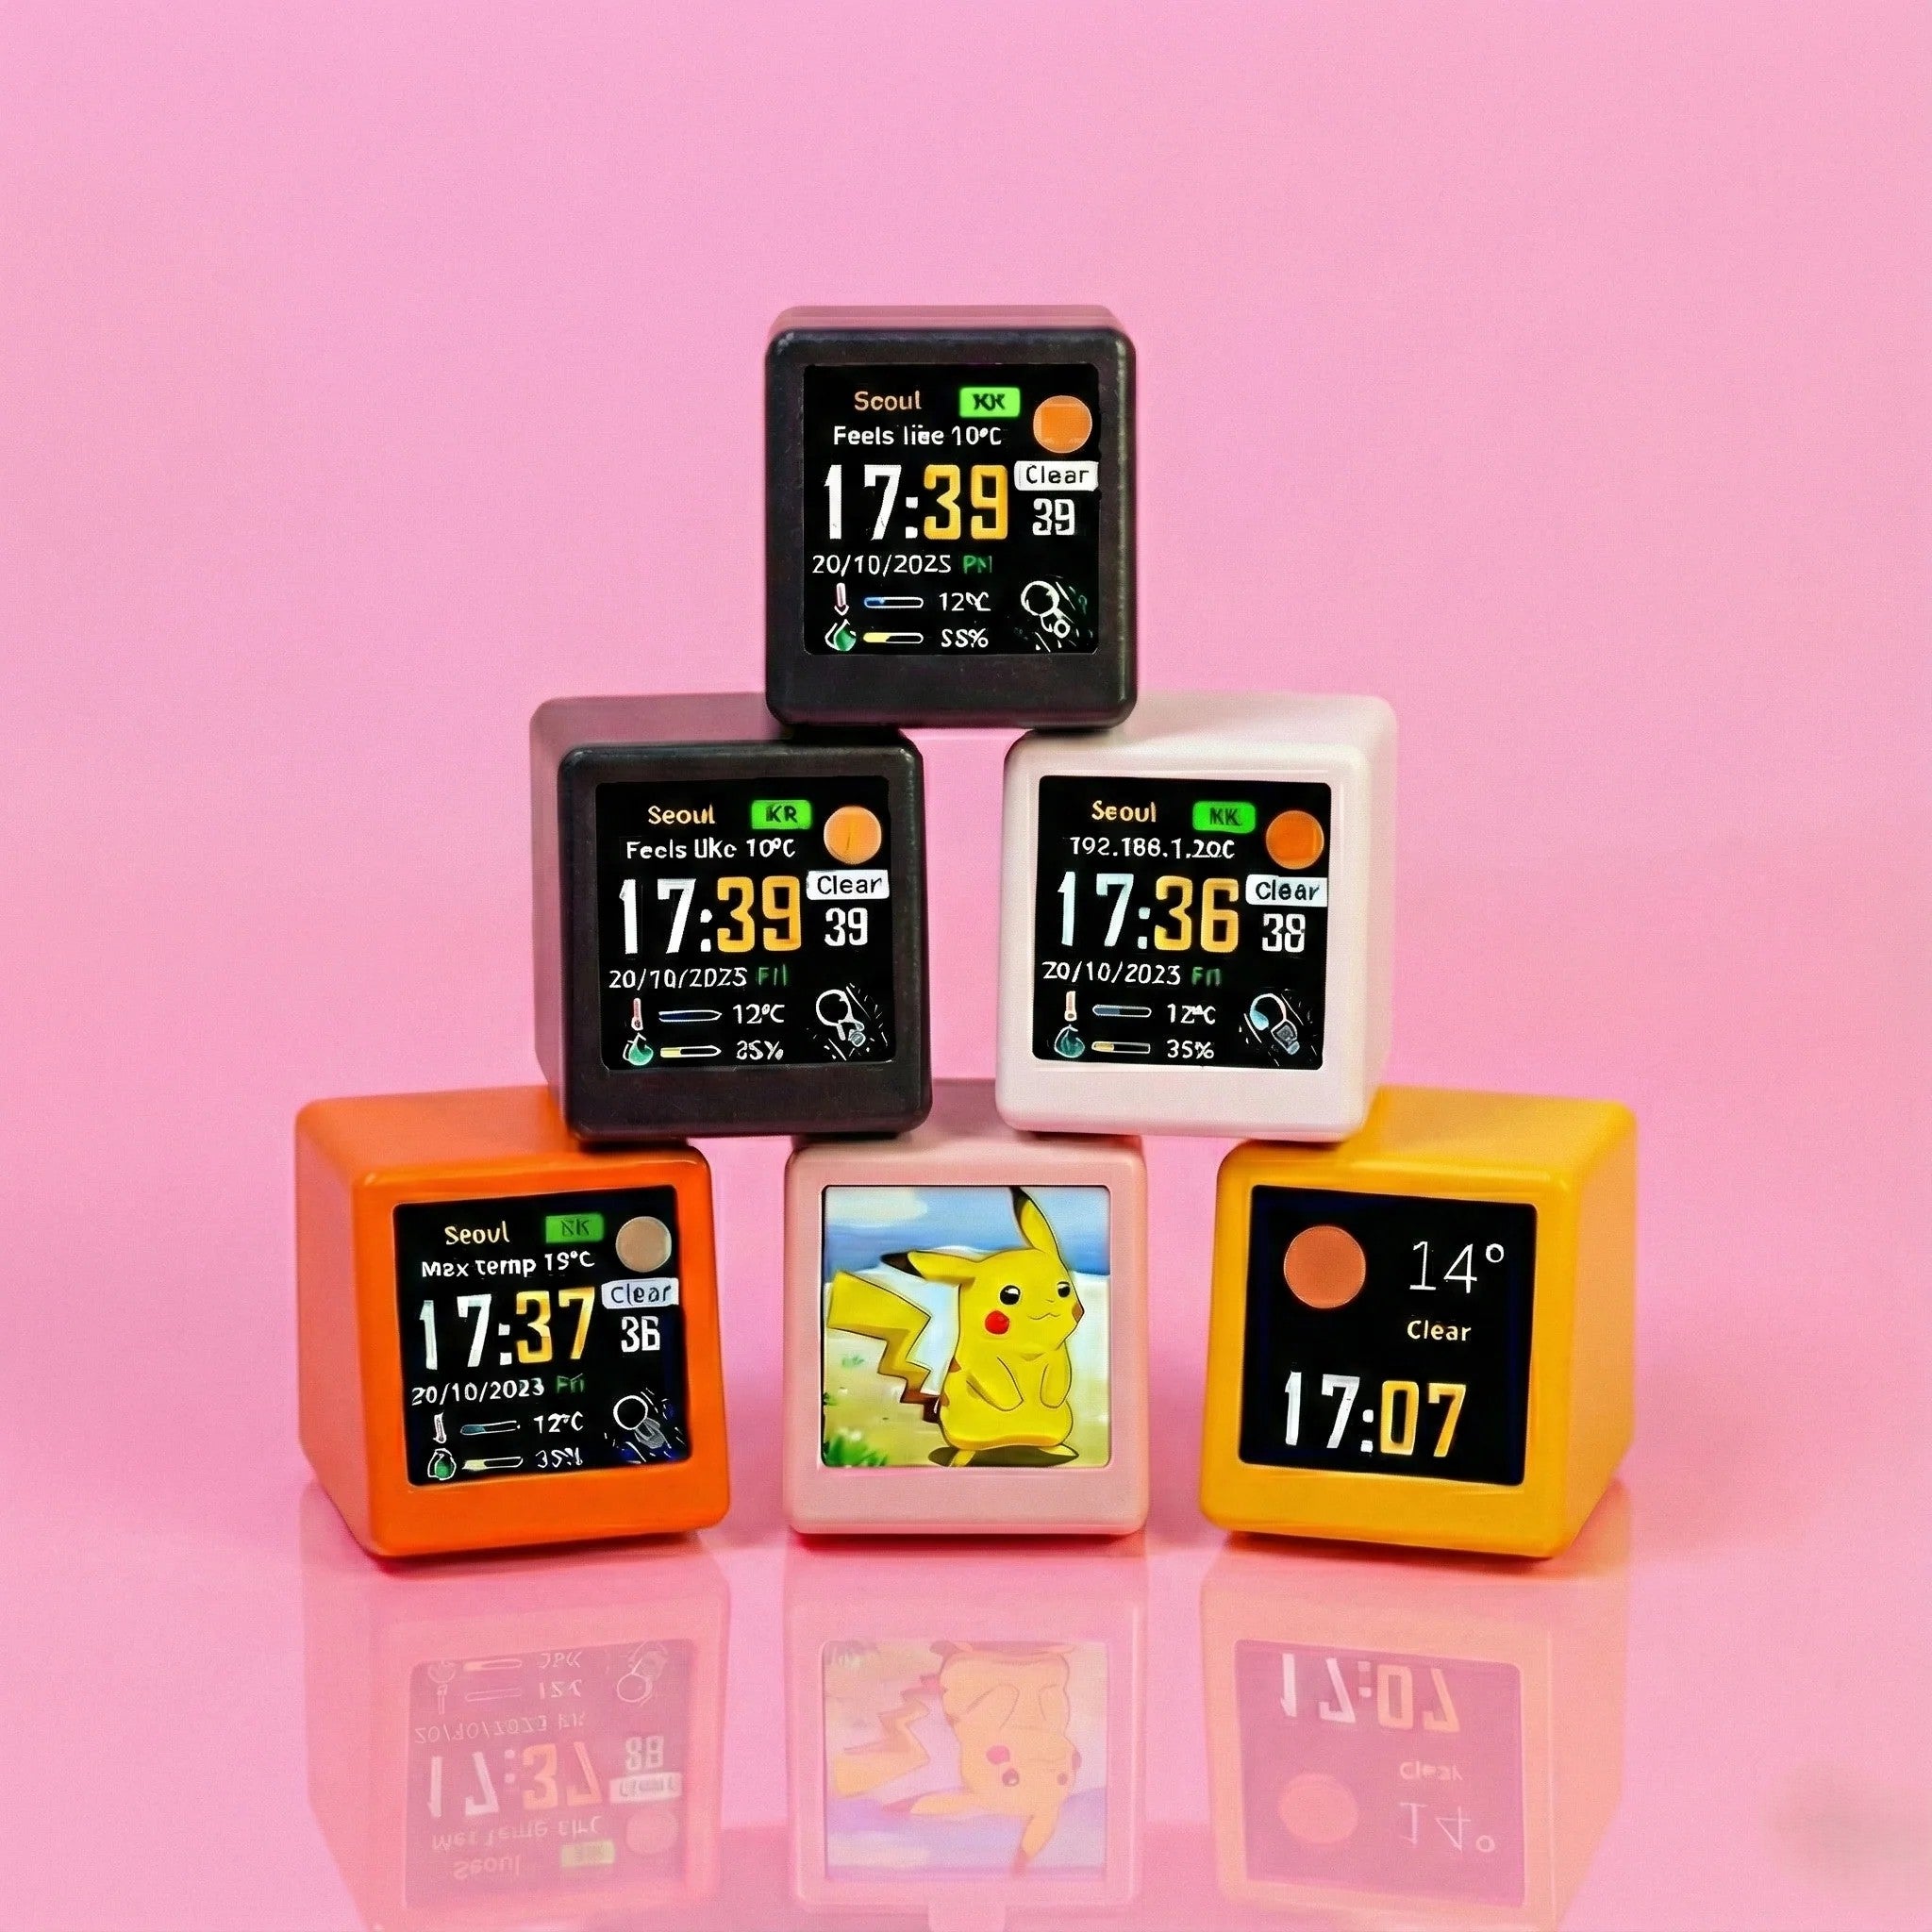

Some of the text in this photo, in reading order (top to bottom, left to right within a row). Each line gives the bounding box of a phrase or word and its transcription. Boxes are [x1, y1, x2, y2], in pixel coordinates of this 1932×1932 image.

[833, 425, 895, 446] Feels
[1025, 465, 1091, 485] Clear
[824, 463, 1009, 541] 17:39
[1032, 497, 1075, 537] 39
[765, 804, 798, 824] KR
[1091, 799, 1157, 823] Seoul
[817, 875, 883, 895] Clear
[1256, 878, 1320, 901] Clear
[619, 874, 803, 955] 17:39
[1057, 870, 1240, 954] 17:36
[824, 907, 869, 947] 39
[1041, 960, 1181, 985] 20/10/2023
[1166, 1039, 1215, 1059] 35%
[444, 1220, 510, 1245] Seoul
[475, 1257, 537, 1278] temp
[1408, 1240, 1505, 1294] 14°
[610, 1283, 672, 1307] Clear
[419, 1286, 596, 1371] 17:37
[1407, 1319, 1472, 1341] Clear
[411, 1376, 545, 1406] 20/10/2023
[1284, 1370, 1467, 1458] 17:07
